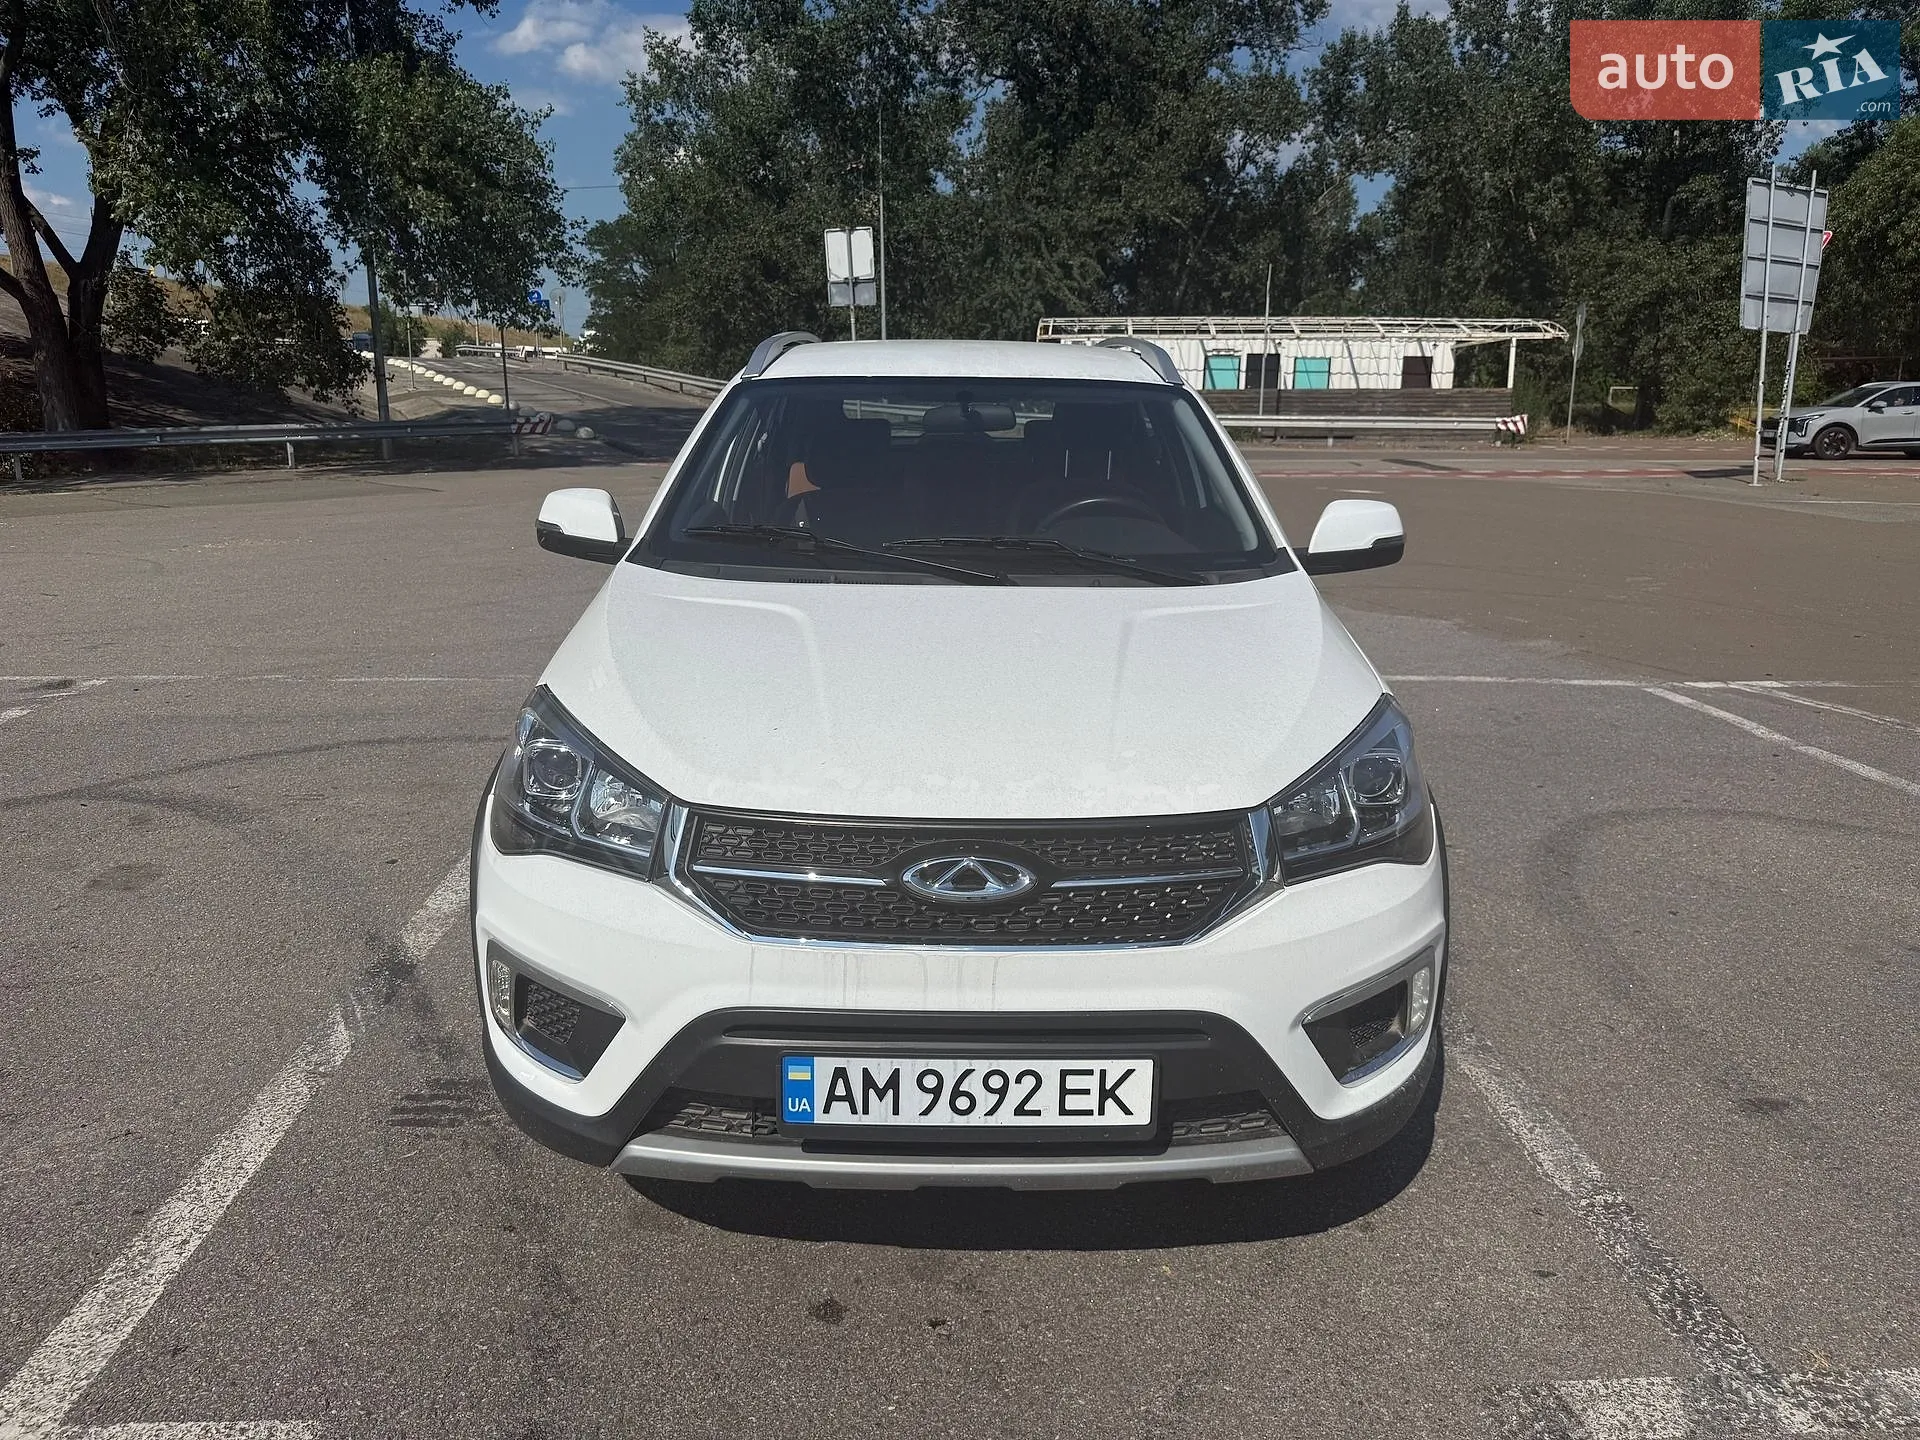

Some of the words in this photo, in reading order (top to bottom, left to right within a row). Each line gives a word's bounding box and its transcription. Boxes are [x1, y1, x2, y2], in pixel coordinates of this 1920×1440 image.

[788, 1098, 811, 1113] UA
[822, 1066, 900, 1116] AM
[915, 1068, 1043, 1117] 9692
[1058, 1068, 1137, 1116] EK
